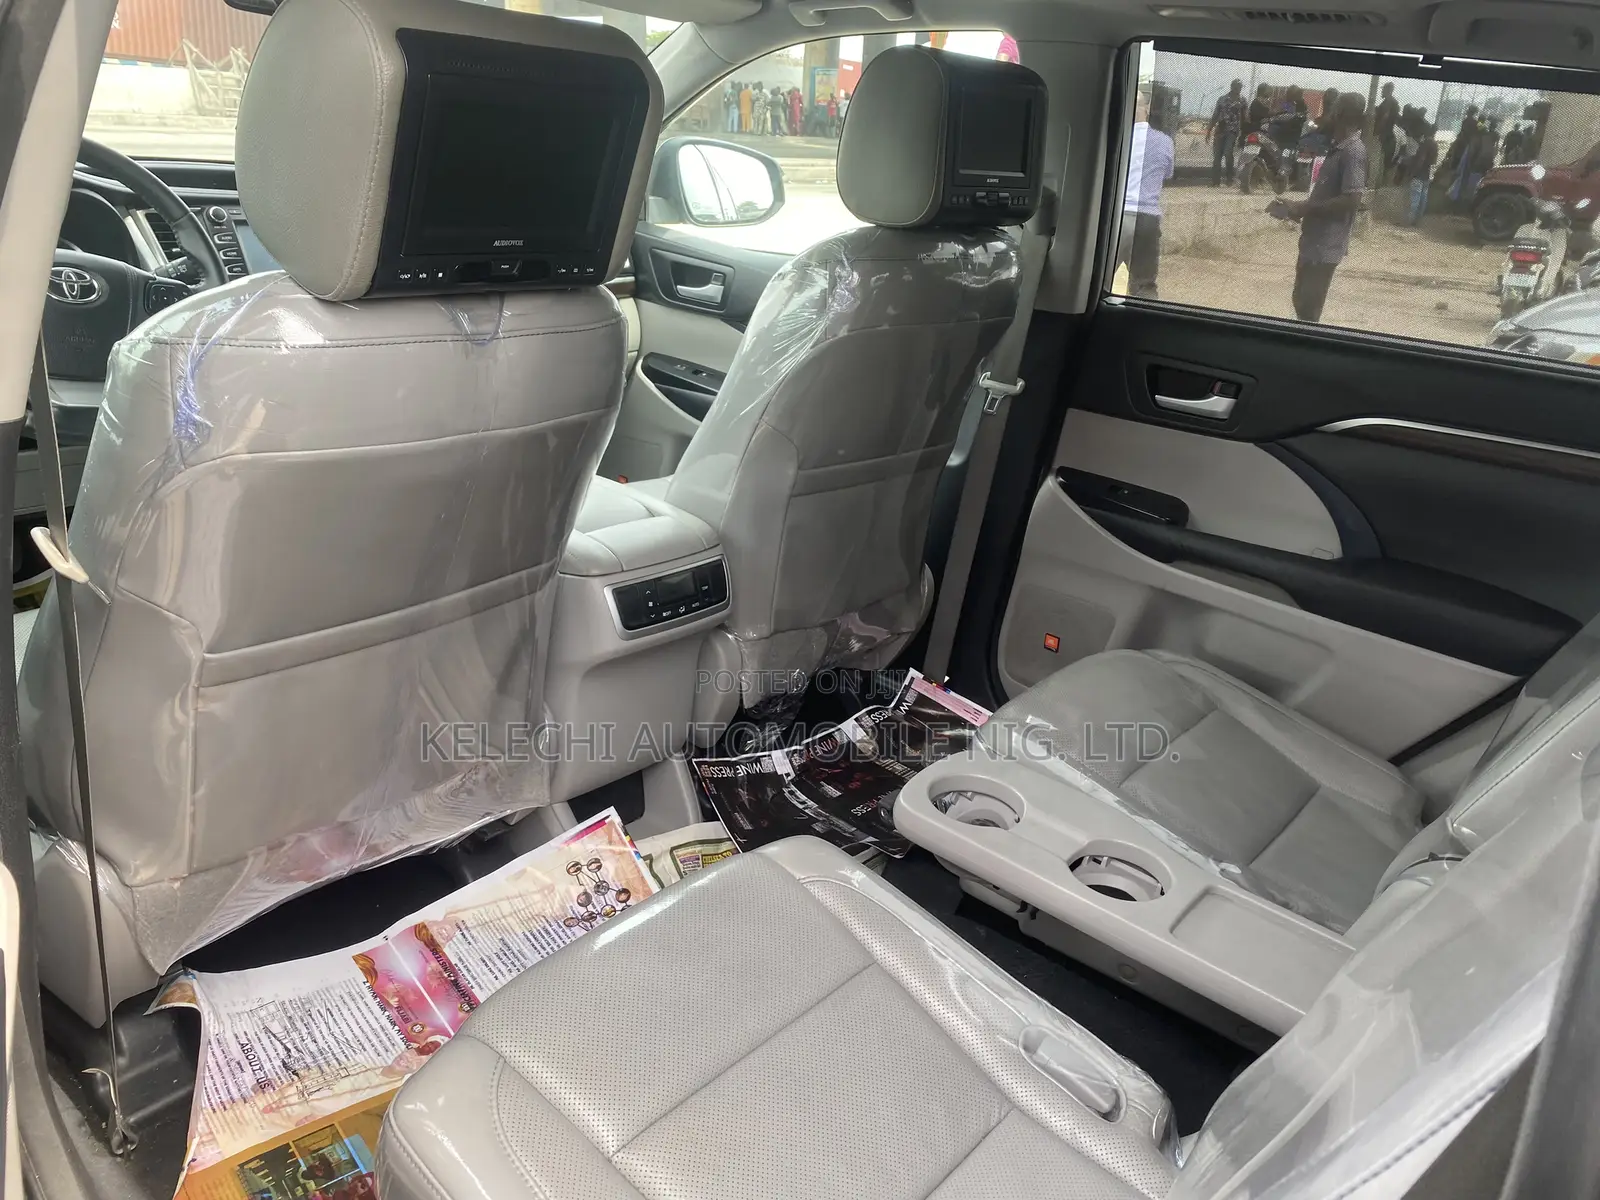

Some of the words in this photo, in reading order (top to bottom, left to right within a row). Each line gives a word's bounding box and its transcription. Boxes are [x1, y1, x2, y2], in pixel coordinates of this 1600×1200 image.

[493, 239, 523, 247] AUDIOVOX
[710, 766, 735, 778] PRESS
[736, 762, 764, 777] WINE
[238, 1039, 262, 1075] ABOUT
[255, 1075, 269, 1090] US
